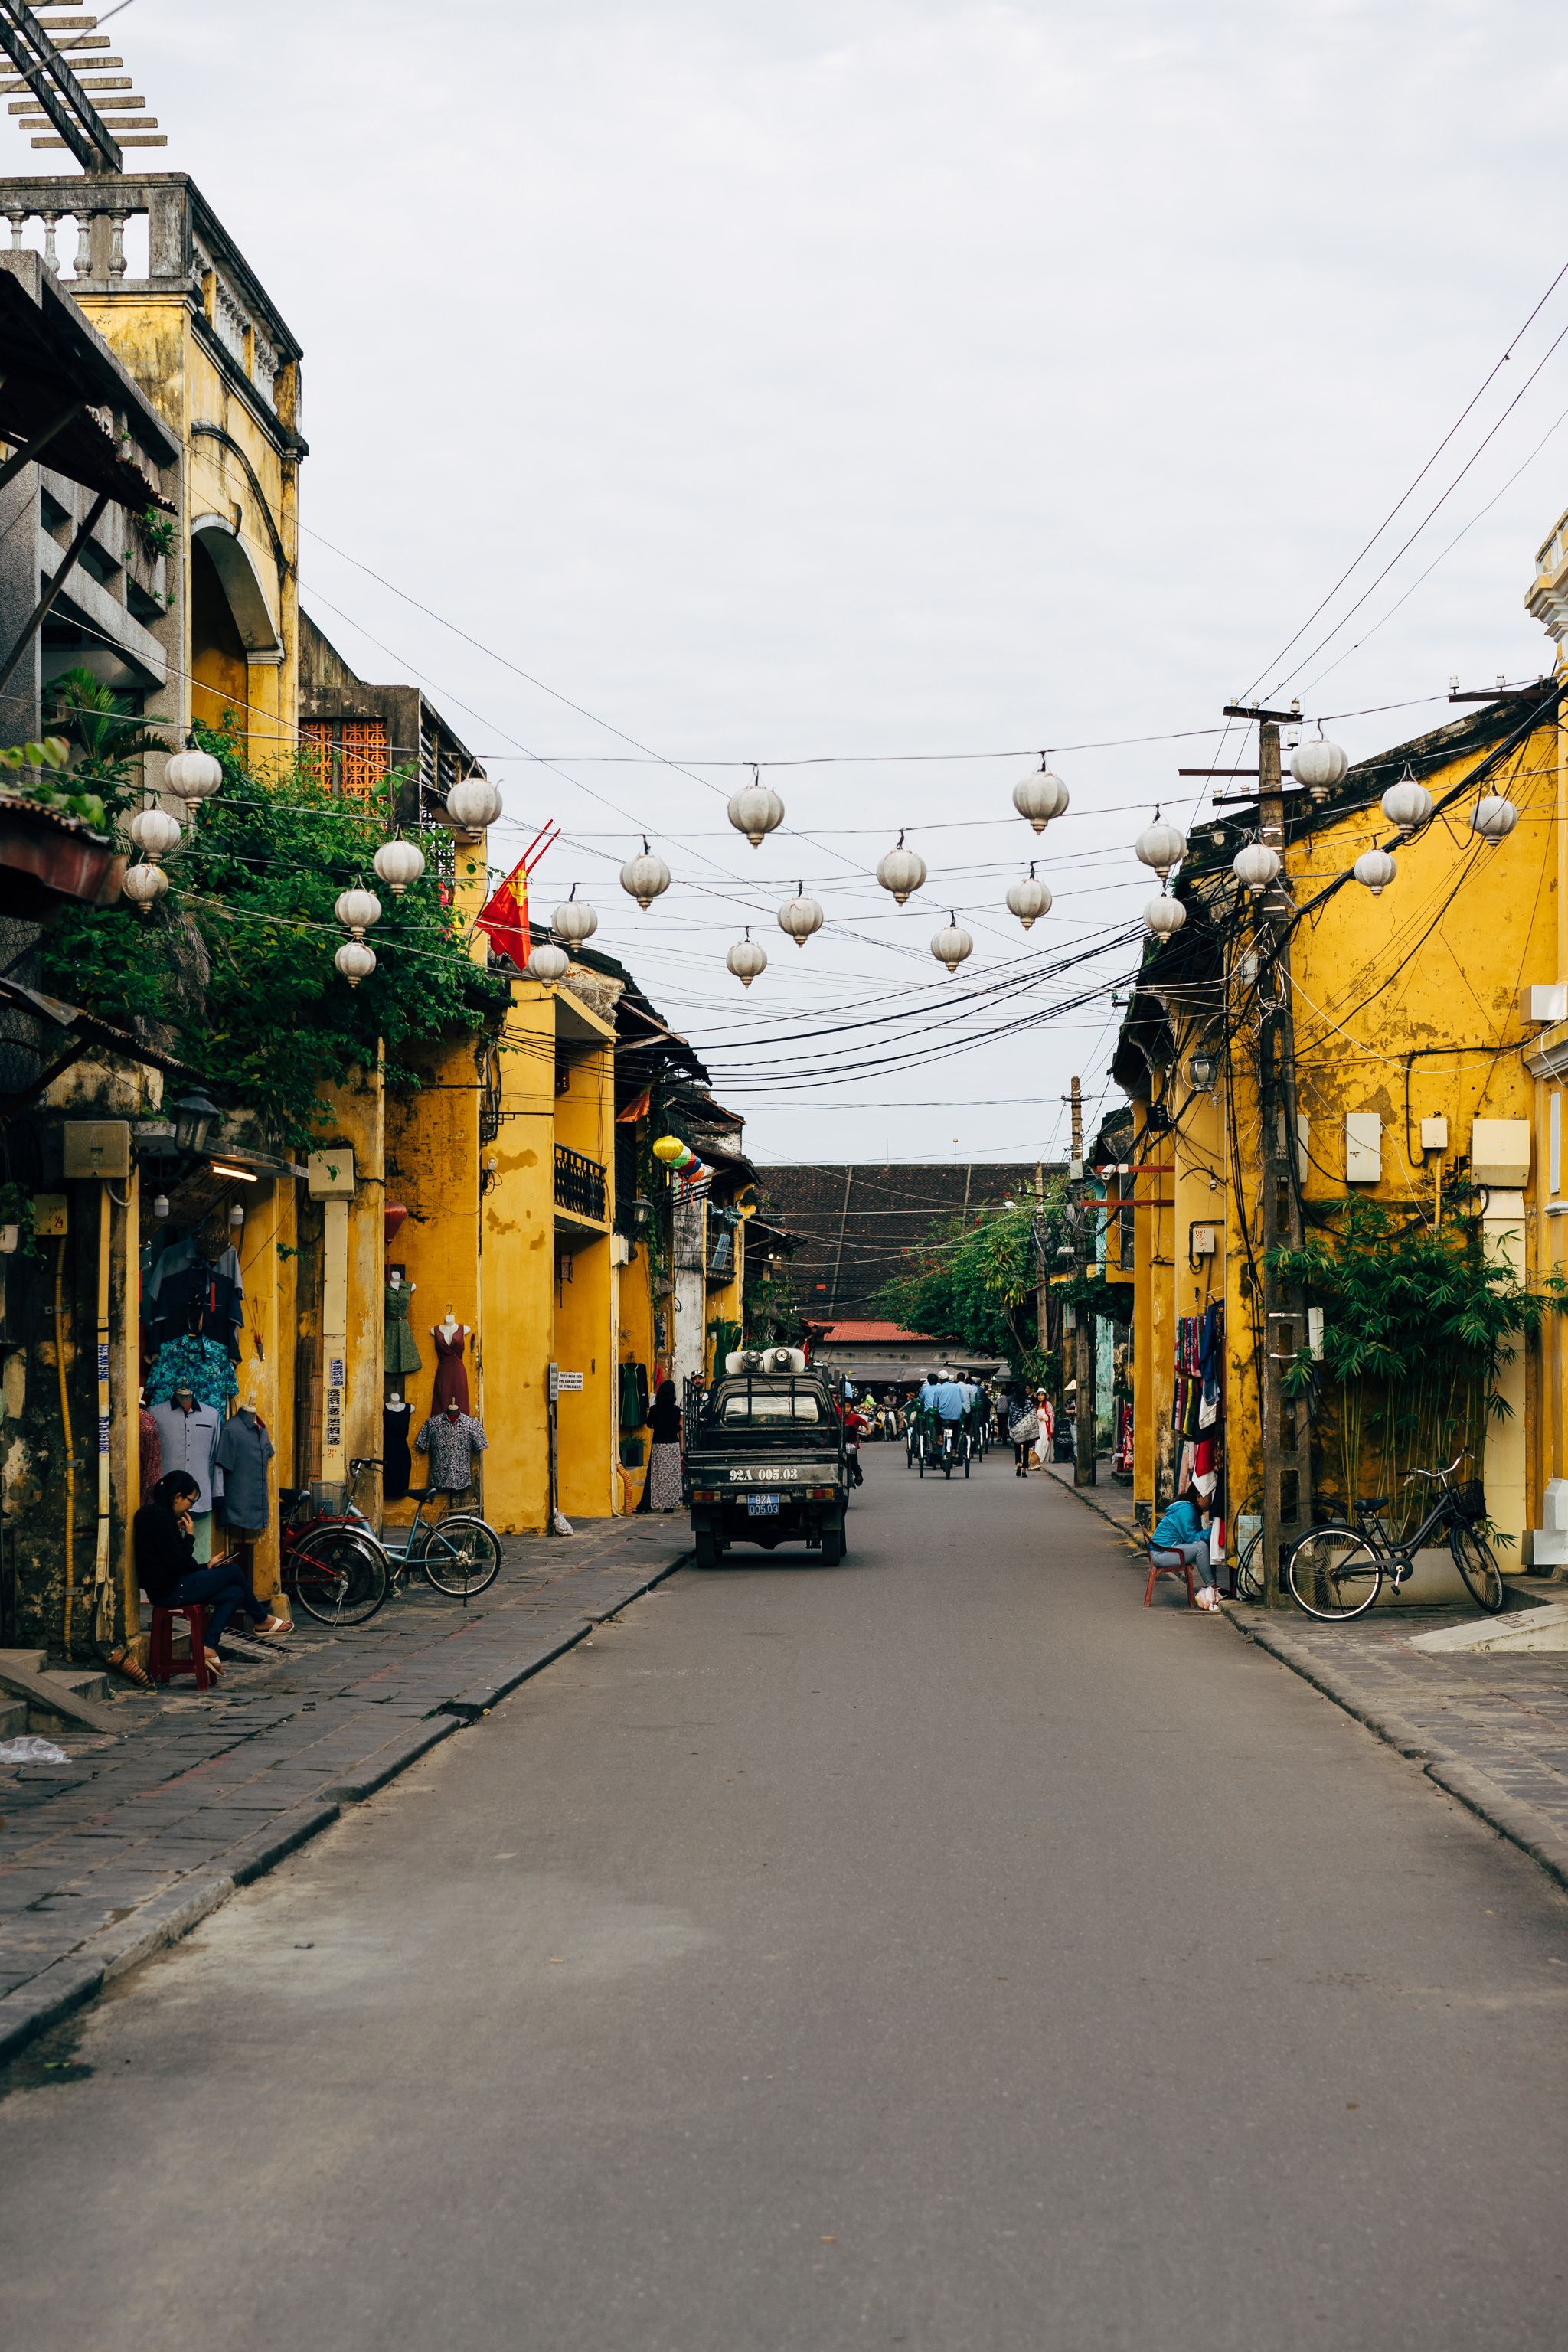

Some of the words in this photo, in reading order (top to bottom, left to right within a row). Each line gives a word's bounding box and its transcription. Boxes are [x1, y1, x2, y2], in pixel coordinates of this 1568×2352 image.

[729, 1469, 753, 1481] 92A
[758, 1468, 799, 1481] 005.03
[755, 1494, 772, 1504] 92A
[749, 1504, 779, 1514] 005.03
